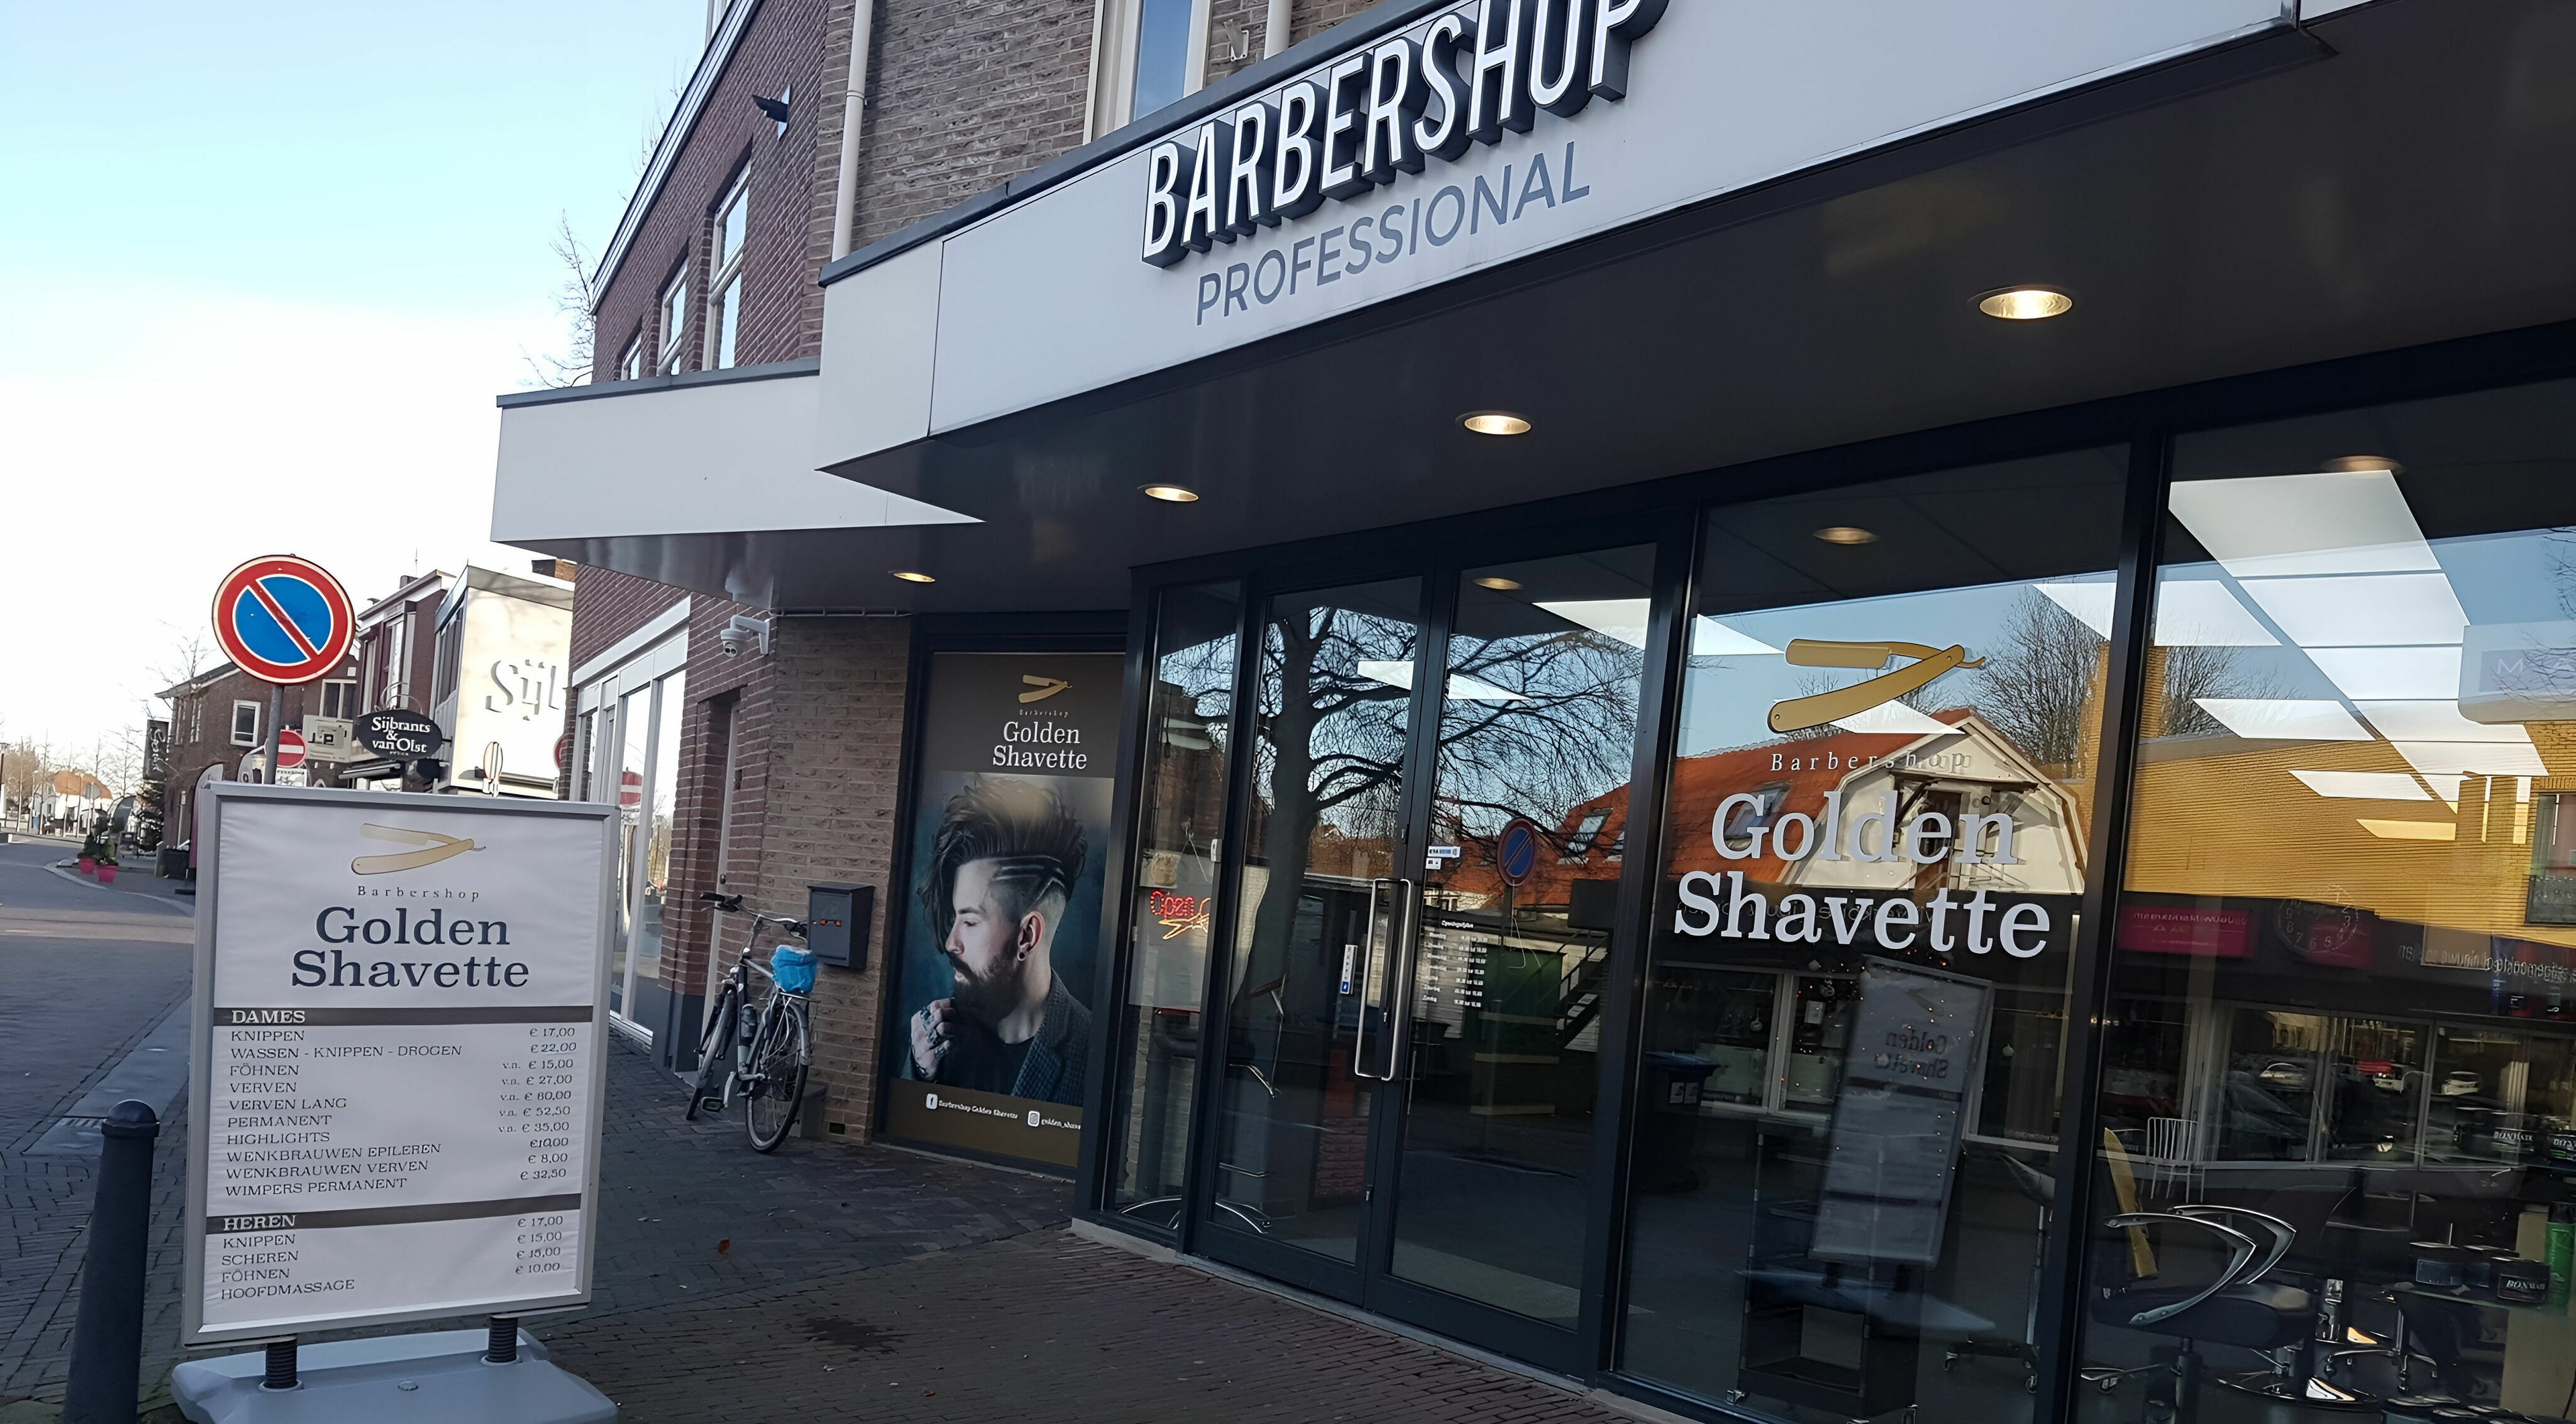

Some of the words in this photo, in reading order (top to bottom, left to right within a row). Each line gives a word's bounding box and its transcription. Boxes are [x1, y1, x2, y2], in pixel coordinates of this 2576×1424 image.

[1195, 140, 1591, 327] PROFESSIONAL
[371, 716, 431, 733] Sijbrants
[386, 730, 399, 741] &
[1003, 721, 1081, 744] Golden
[372, 740, 395, 751] van
[396, 737, 427, 753] Olst
[992, 745, 1087, 769] Shavette
[1770, 750, 1966, 773] Barbershop
[1711, 790, 2018, 866] Golden
[358, 885, 480, 903] Barbershop
[1674, 871, 2051, 959] Shavette
[315, 906, 511, 946] Golden
[291, 949, 530, 989] Shavette
[231, 1010, 306, 1024] DAMES
[231, 1030, 305, 1042] KNIPPEN
[529, 1028, 539, 1037] €
[231, 1048, 299, 1059] WASSEN
[313, 1046, 384, 1058] KNIPPEN
[531, 1044, 539, 1053] €
[229, 1062, 299, 1076] FÖHNEN
[529, 1060, 537, 1069] €
[229, 1082, 297, 1093] VERVEN
[526, 1077, 535, 1085] €
[524, 1092, 533, 1101] €
[229, 1099, 296, 1111] VERVEN
[302, 1098, 347, 1110] LANG
[523, 1107, 532, 1117] €
[227, 1115, 333, 1128] PERMANENT
[522, 1123, 531, 1133] €
[227, 1132, 331, 1145] HIGHLIGHTS
[227, 1147, 363, 1162] WENKBRAUWEN
[368, 1143, 442, 1158] EPILEREN
[528, 1154, 537, 1164] €
[226, 1164, 362, 1180] WENKBRAUWEN
[367, 1160, 429, 1174] VERVEN
[520, 1170, 529, 1181] €
[225, 1183, 303, 1197] WIMPERS
[308, 1178, 407, 1193] PERMANENT
[223, 1214, 297, 1231] HEREN
[517, 1218, 527, 1227] €
[223, 1234, 296, 1249] KNIPPEN
[517, 1234, 525, 1244] €
[221, 1250, 299, 1266] SCHEREN
[517, 1250, 525, 1260] €
[221, 1268, 290, 1283] FÖHNEN
[515, 1266, 523, 1275] €
[221, 1278, 356, 1300] HOOFDMASSAGE
